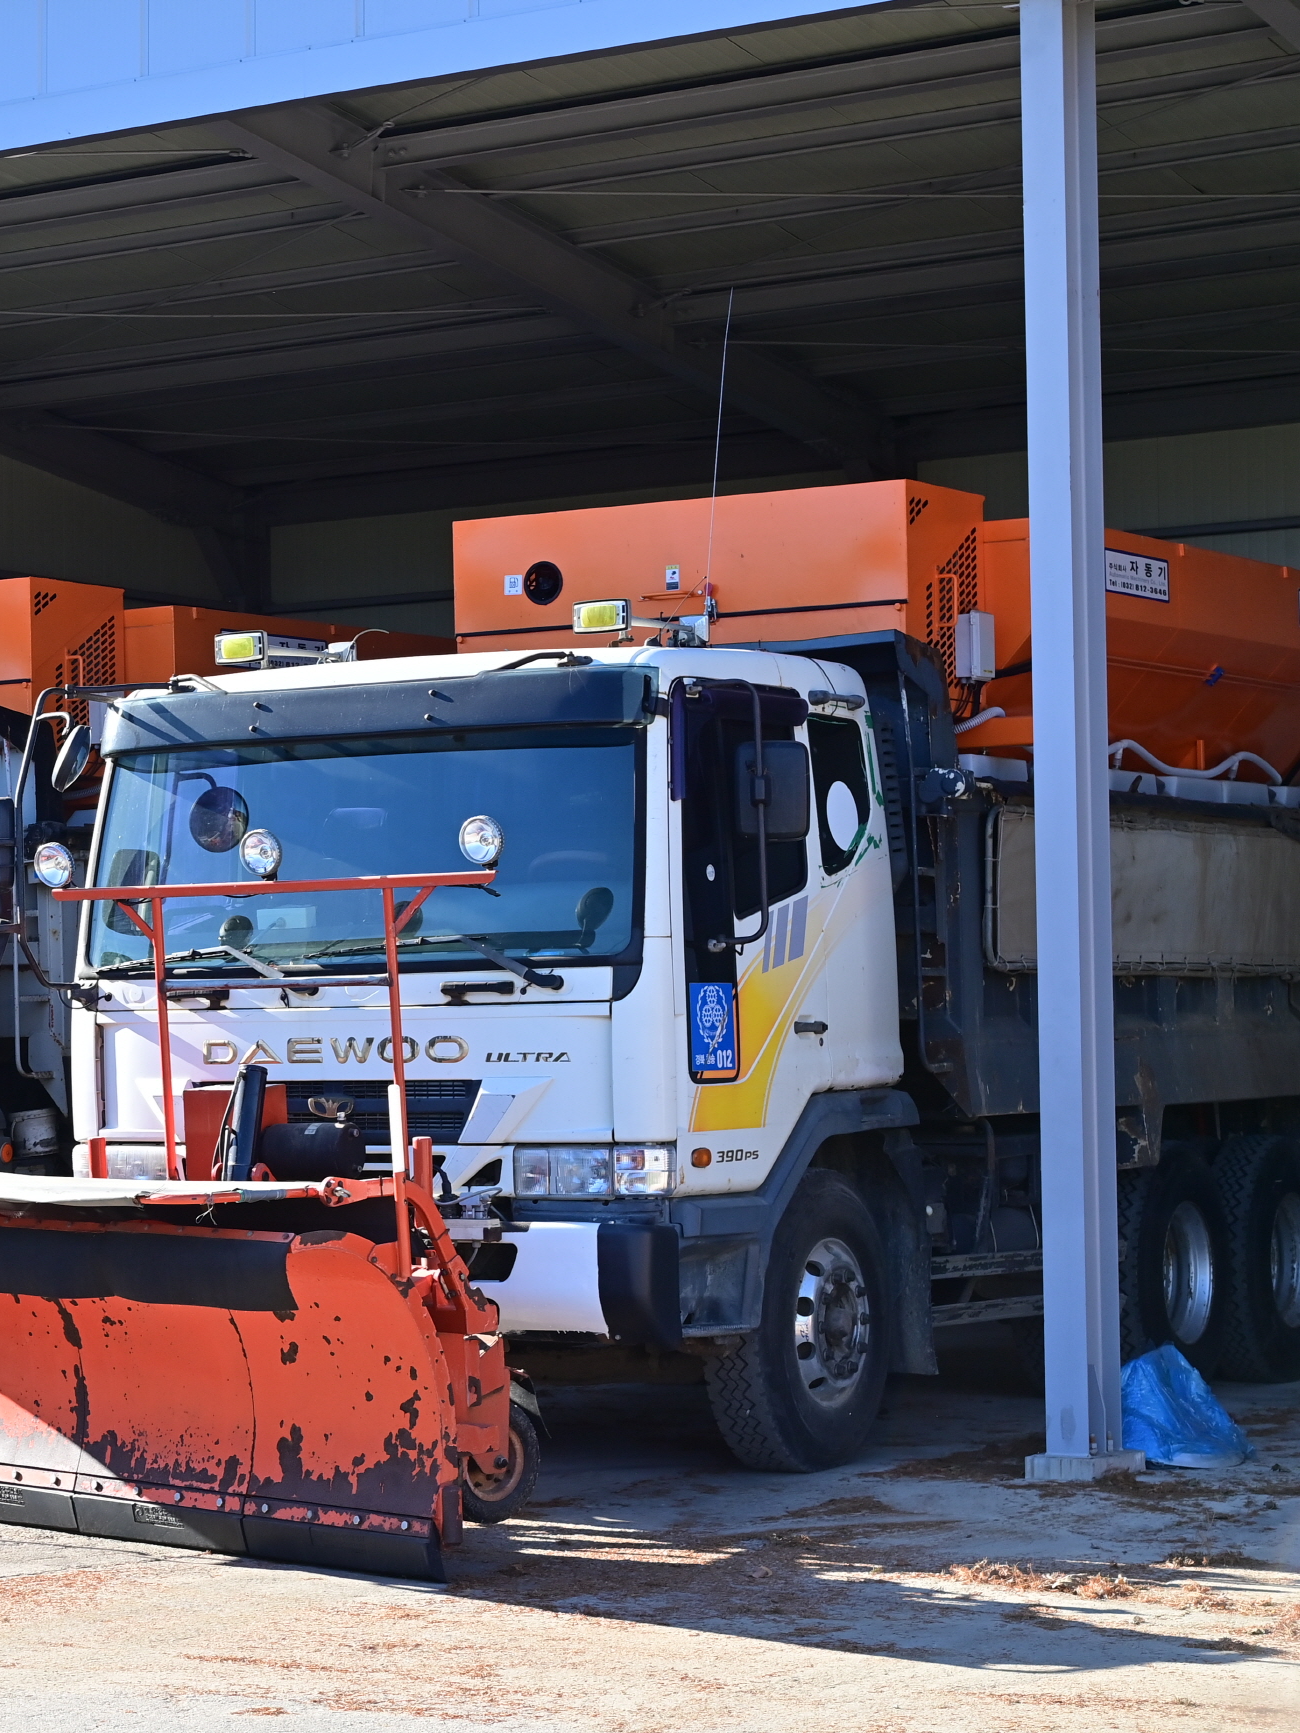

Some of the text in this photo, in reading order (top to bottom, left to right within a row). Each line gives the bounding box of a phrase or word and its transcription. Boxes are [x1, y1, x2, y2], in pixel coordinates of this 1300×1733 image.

[203, 1035, 572, 1065] DAEWOO ULTRA
[717, 1049, 733, 1068] 012
